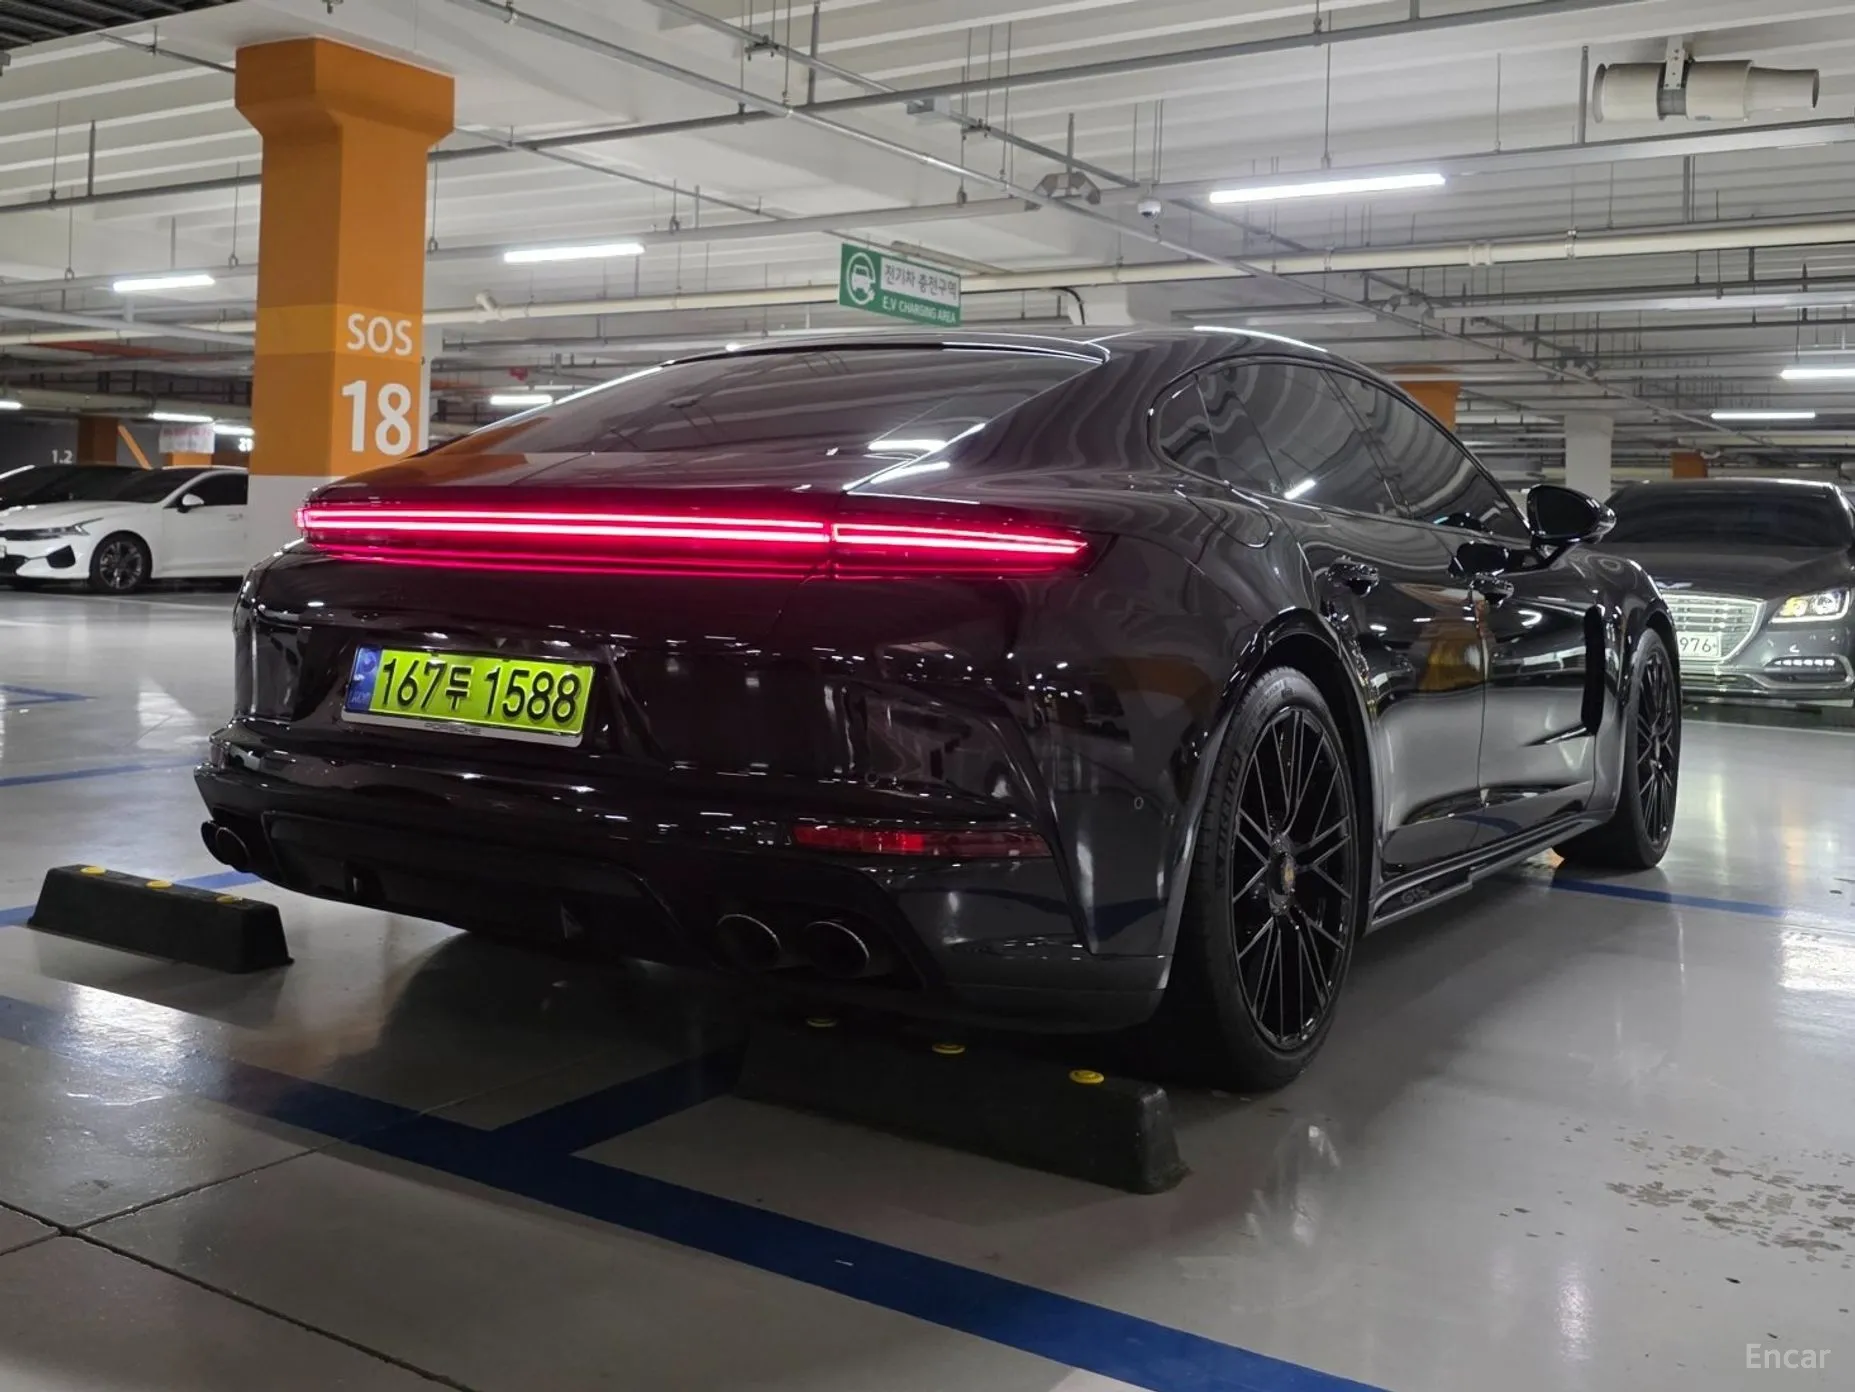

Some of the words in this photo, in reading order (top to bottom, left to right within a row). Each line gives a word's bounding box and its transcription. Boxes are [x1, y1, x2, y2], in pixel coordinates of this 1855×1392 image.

[885, 264, 915, 288] 전기차
[918, 273, 957, 300] 충전구역
[347, 313, 413, 356] SOS
[937, 309, 956, 324] AREA
[342, 380, 412, 455] 18
[382, 657, 474, 712] 167두
[484, 666, 582, 724] 1588
